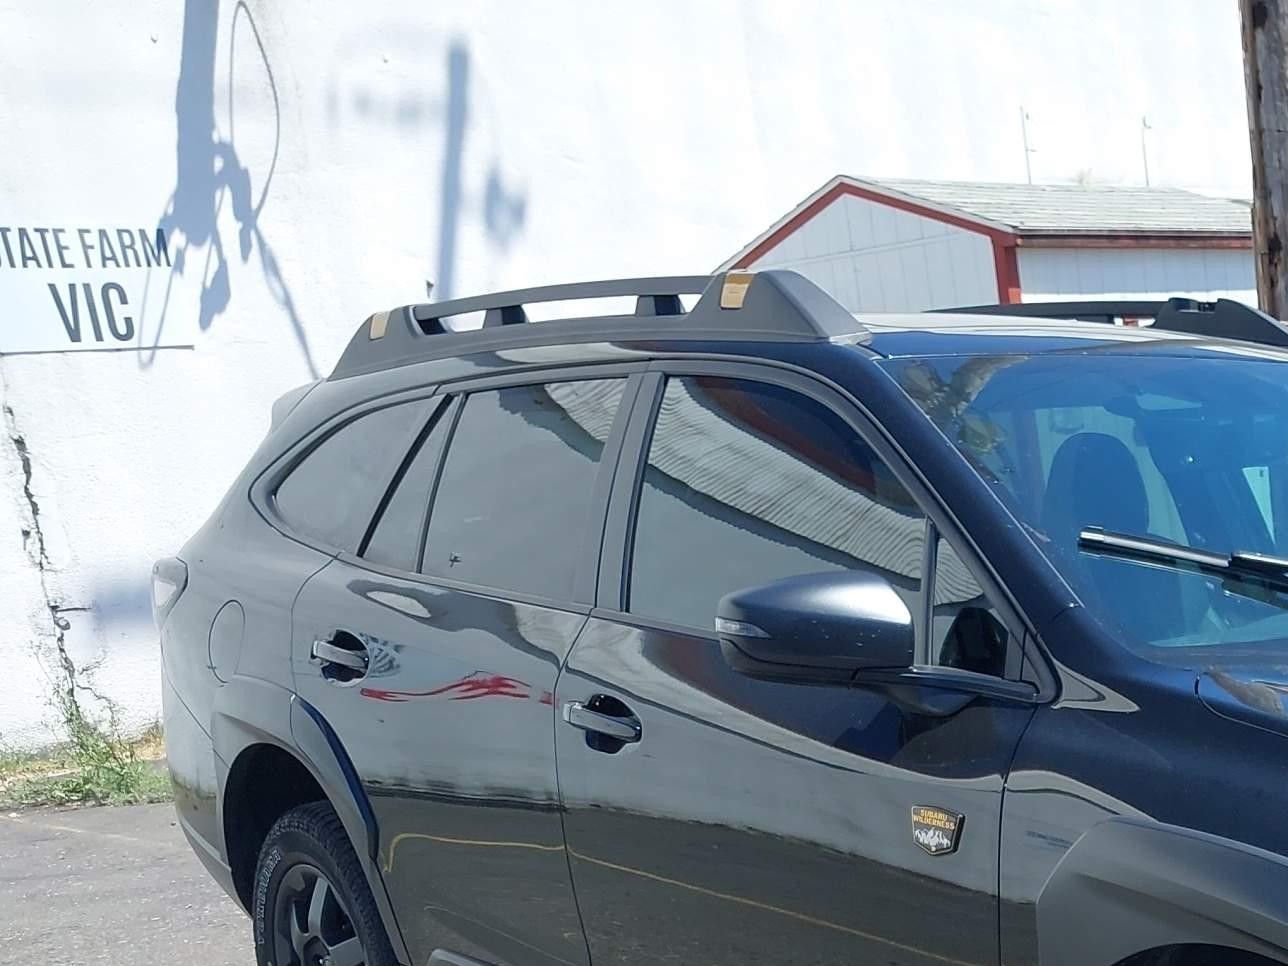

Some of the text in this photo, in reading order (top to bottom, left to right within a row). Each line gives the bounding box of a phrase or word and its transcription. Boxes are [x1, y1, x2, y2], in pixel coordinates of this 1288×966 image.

[0, 227, 173, 269] TATE FARM
[47, 281, 135, 343] VIC
[913, 814, 955, 830] WILDERNESS
[920, 809, 949, 821] SUBARU
